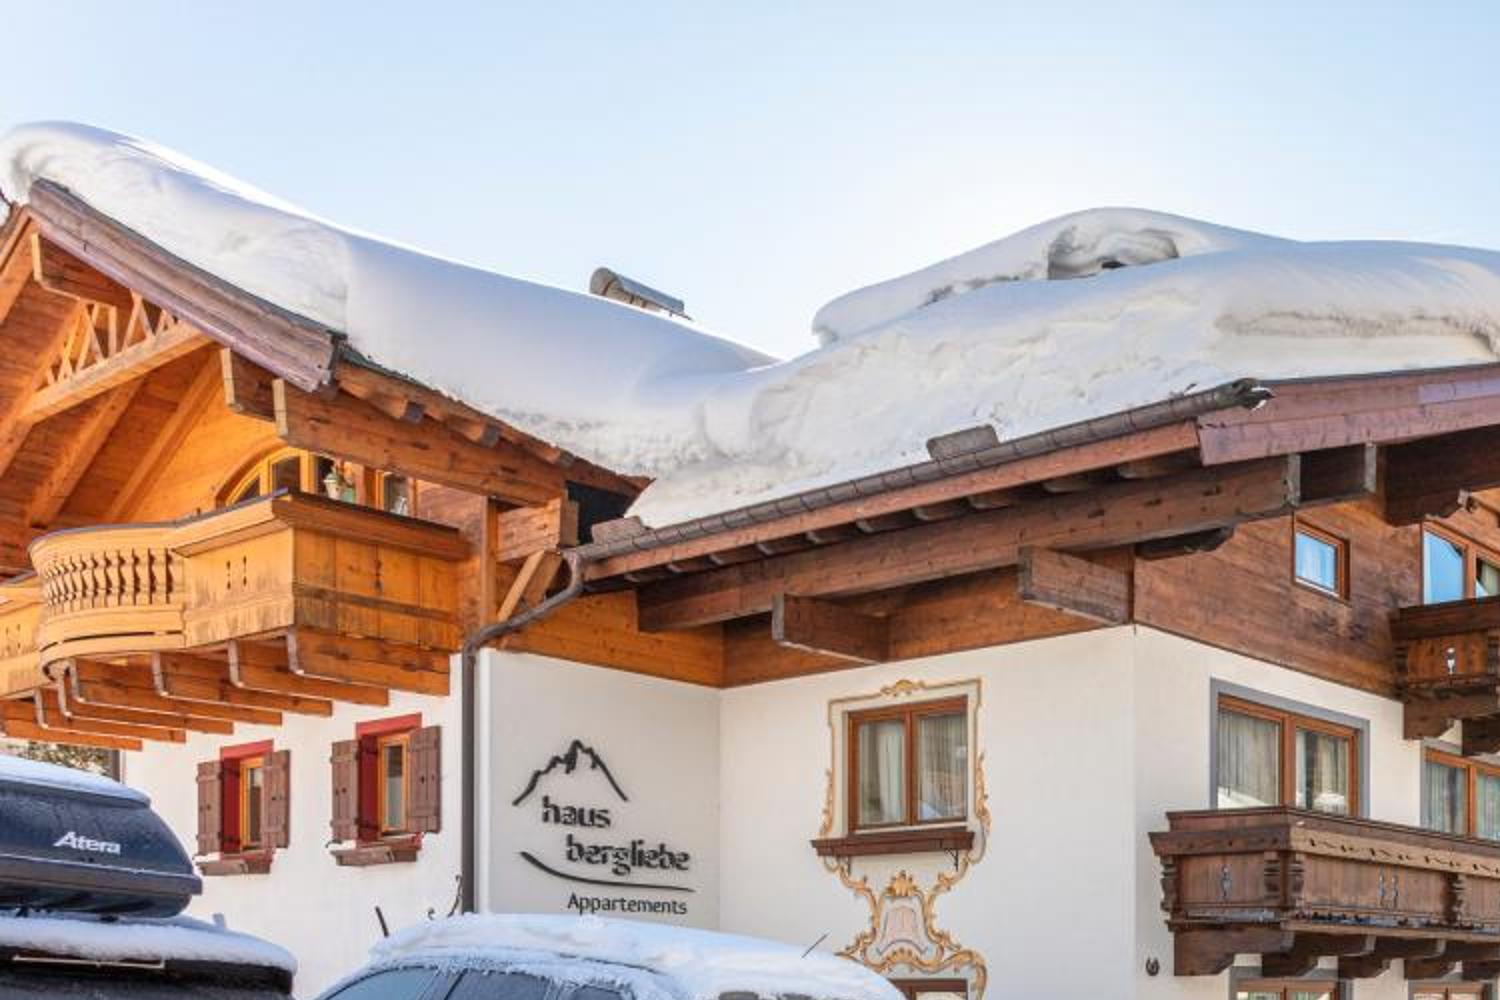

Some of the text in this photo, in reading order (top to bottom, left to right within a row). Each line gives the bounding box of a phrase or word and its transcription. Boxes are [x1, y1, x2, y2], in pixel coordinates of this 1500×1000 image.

[541, 795, 612, 829] haus
[52, 830, 121, 856] Atera
[566, 833, 691, 877] bergliebe
[567, 891, 688, 916] Appartements
